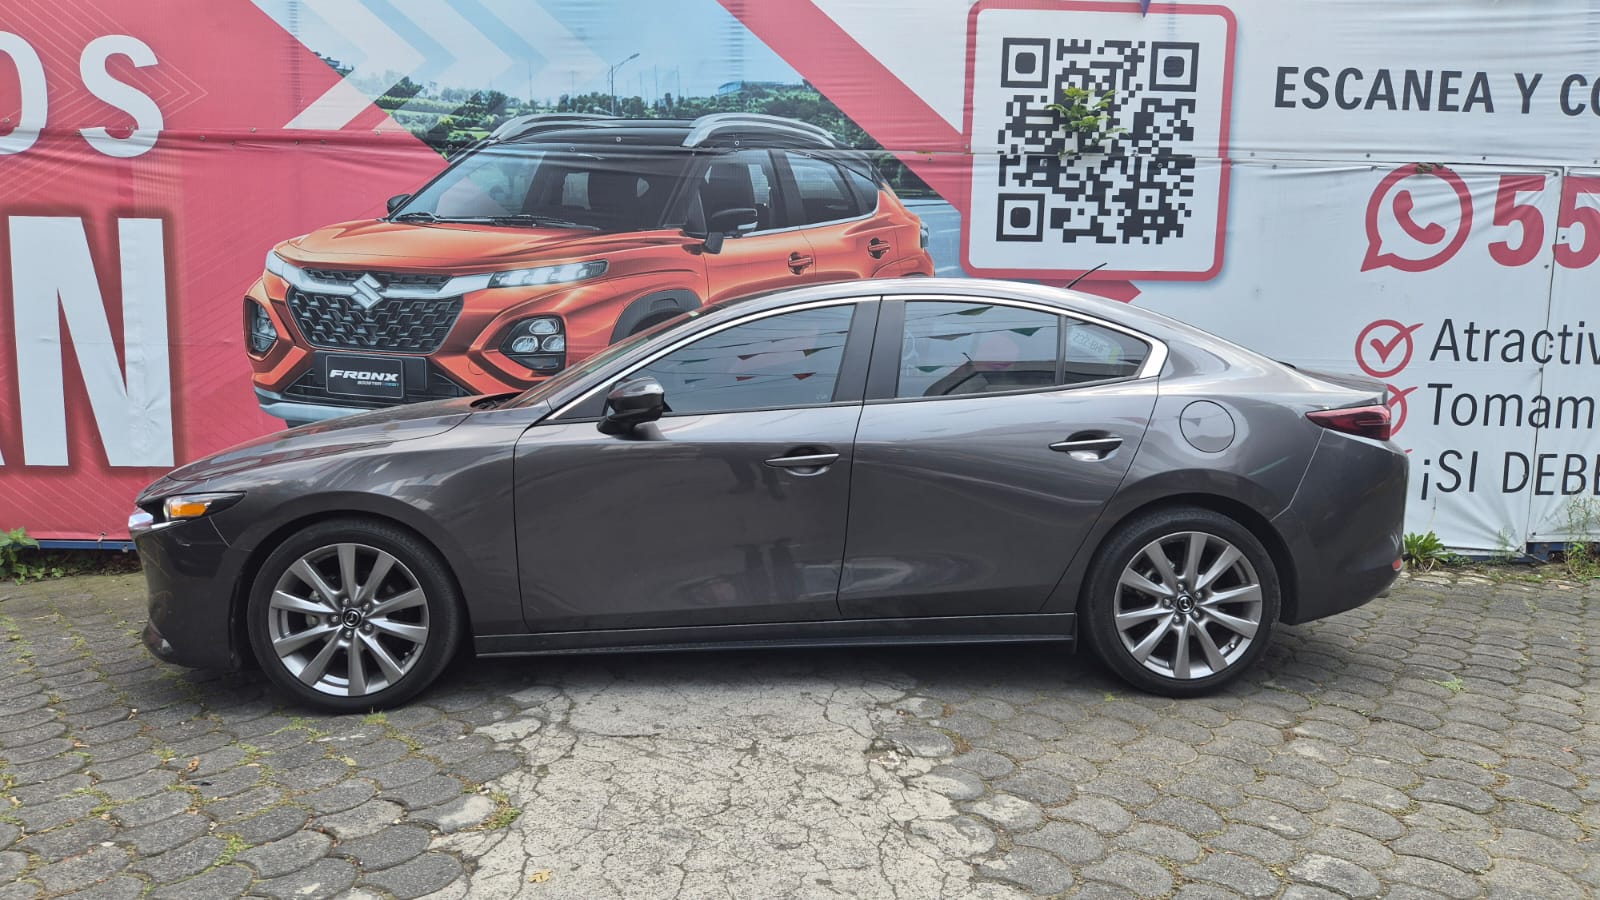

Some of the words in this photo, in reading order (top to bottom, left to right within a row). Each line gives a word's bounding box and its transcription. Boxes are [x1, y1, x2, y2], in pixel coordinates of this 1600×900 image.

[1274, 66, 1495, 113] ESCANEA
[1514, 73, 1543, 114] Y
[1488, 175, 1600, 270] 55
[0, 215, 174, 467] N
[329, 369, 399, 382] FRONX
[1427, 383, 1595, 429] Tomam
[1421, 449, 1478, 500] ¡SI
